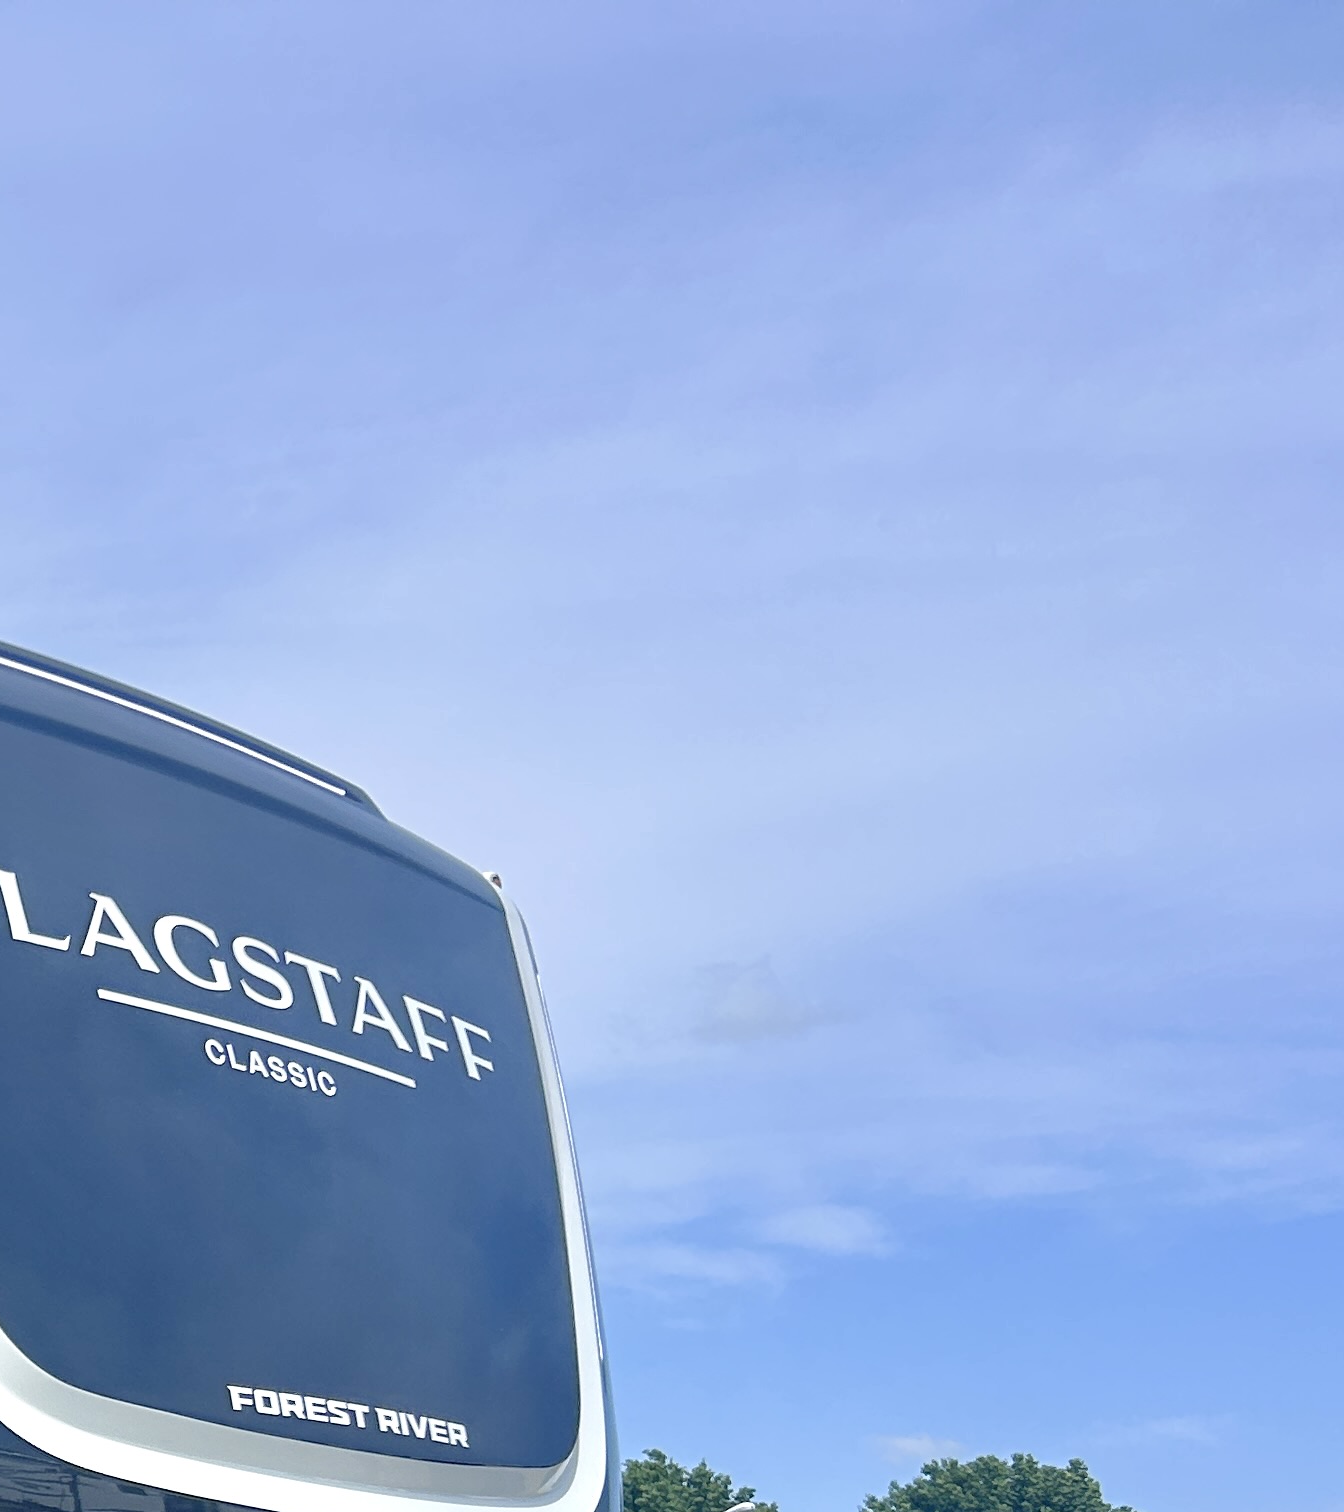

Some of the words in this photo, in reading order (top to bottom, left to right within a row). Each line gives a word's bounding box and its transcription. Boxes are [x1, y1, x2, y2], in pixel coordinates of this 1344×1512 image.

[204, 1037, 338, 1097] CLASSIC
[226, 1384, 370, 1430] FOREST
[375, 1406, 470, 1449] RIVER
